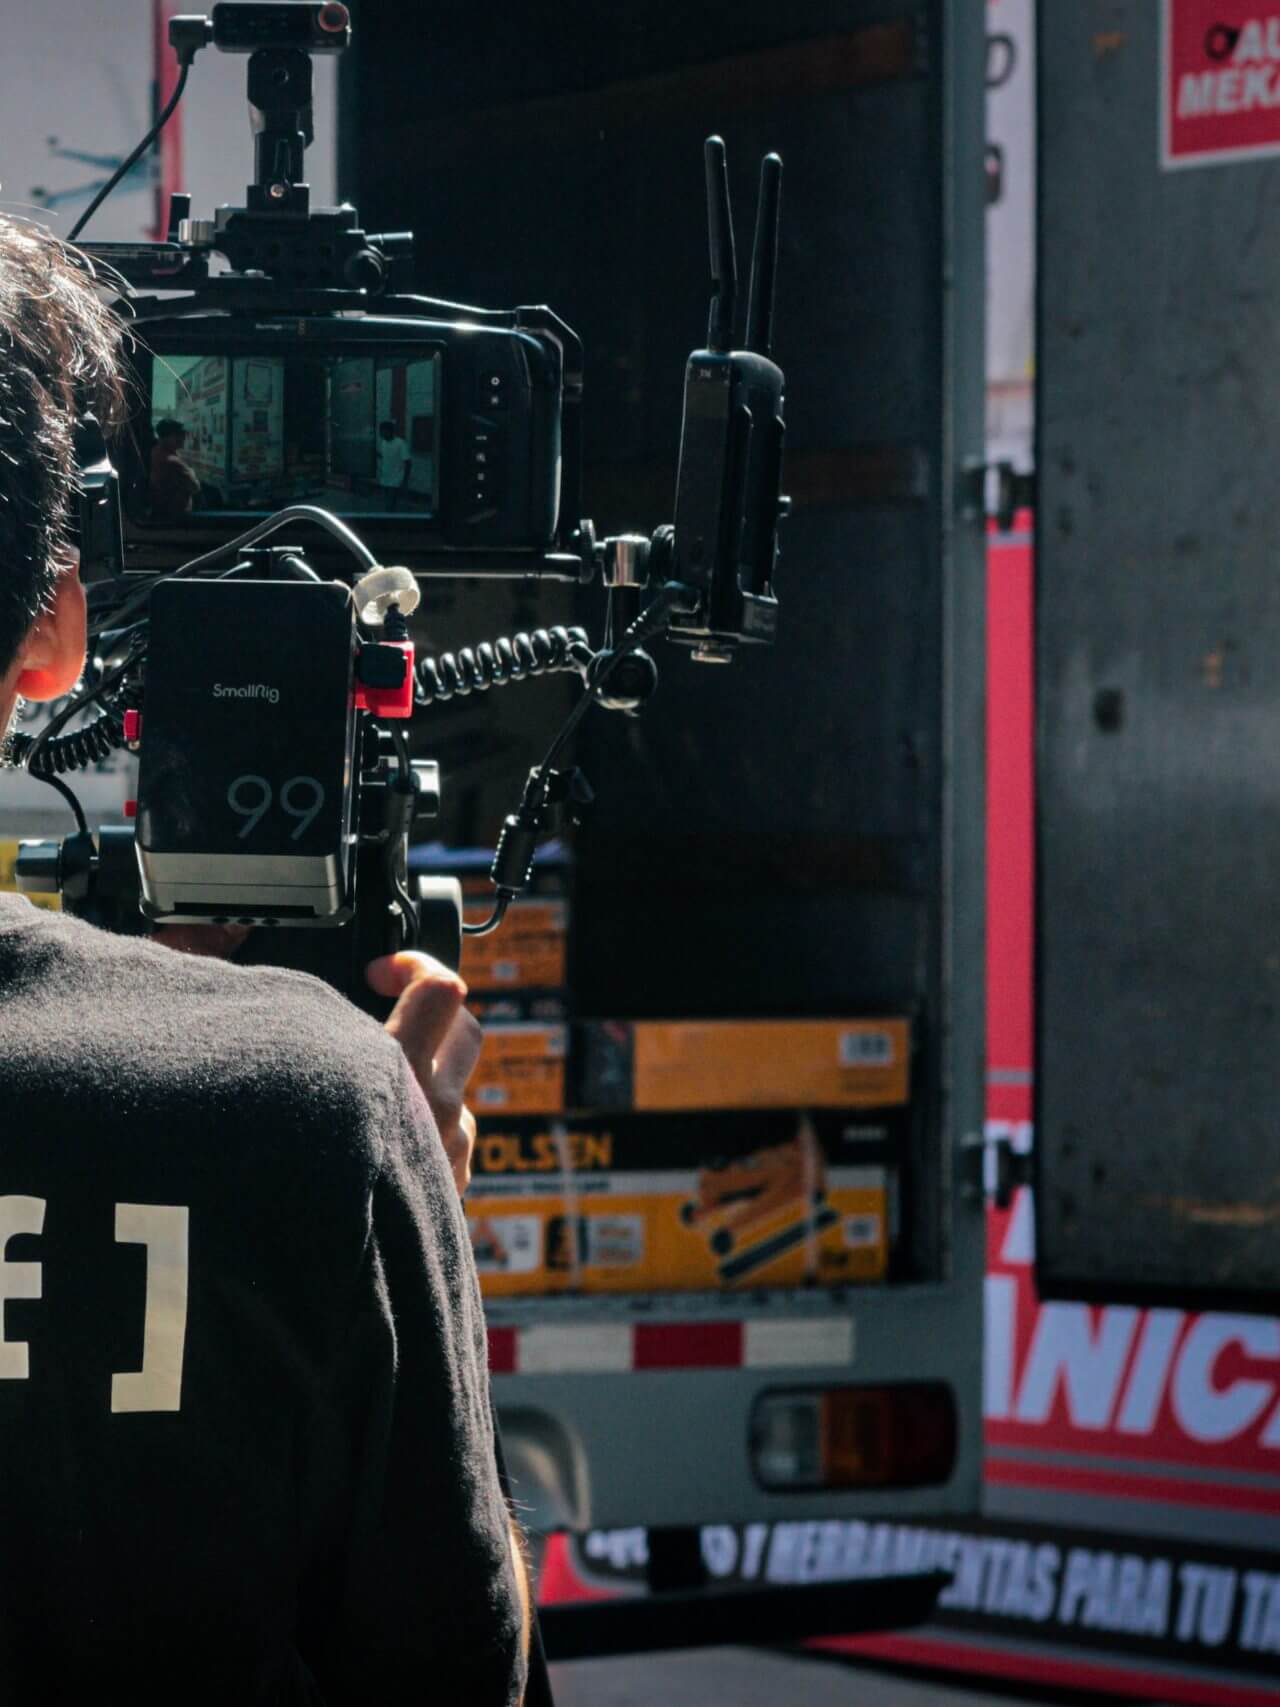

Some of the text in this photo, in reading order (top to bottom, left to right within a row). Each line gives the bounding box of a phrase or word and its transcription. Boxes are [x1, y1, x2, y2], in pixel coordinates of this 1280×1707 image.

[1177, 62, 1280, 119] MEK
[212, 682, 280, 704] SmallRig
[227, 774, 325, 841] 99
[472, 1132, 613, 1172] OLSEN
[983, 1272, 1280, 1447] NIC
[1057, 1549, 1172, 1638] PARA
[1175, 1561, 1238, 1647] TU
